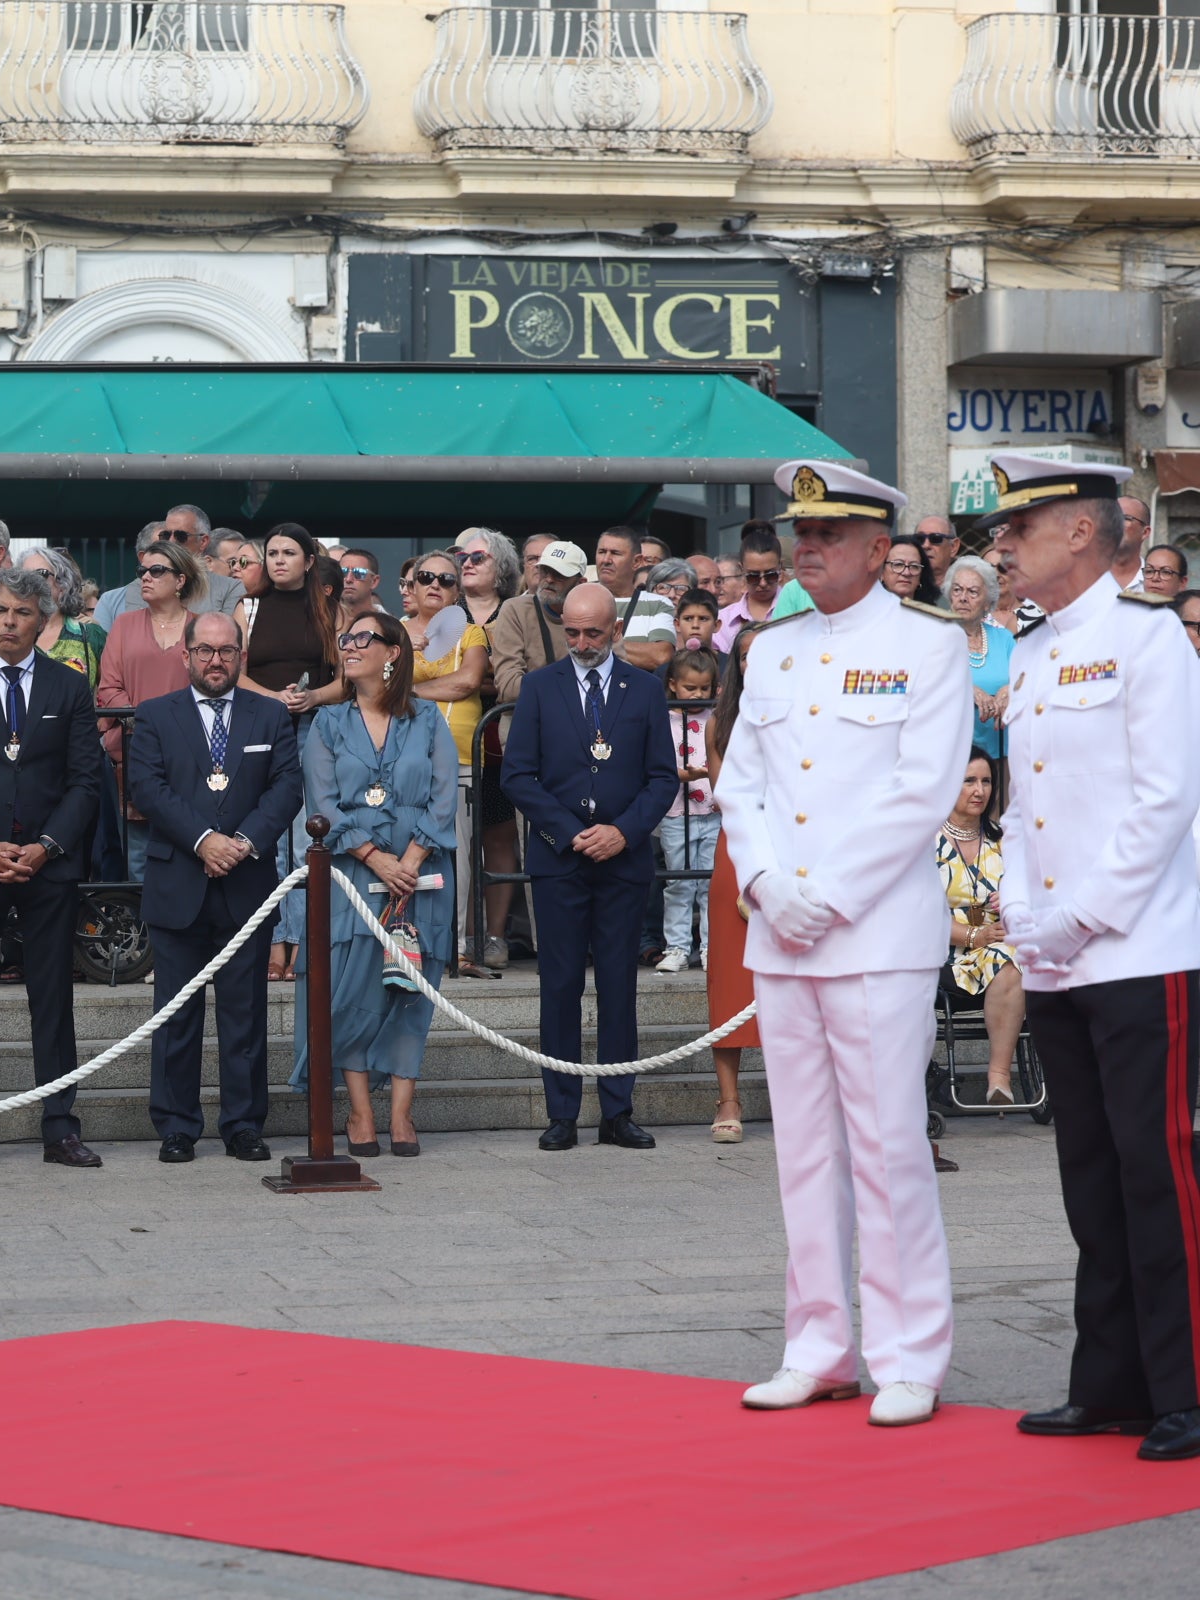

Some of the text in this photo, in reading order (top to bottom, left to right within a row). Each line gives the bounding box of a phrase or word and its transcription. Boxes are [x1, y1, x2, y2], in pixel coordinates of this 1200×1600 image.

[452, 260, 651, 293] LA VIEJA DE
[449, 290, 781, 360] PONCE
[947, 388, 1109, 433] JOYERIA
[551, 549, 567, 560] 201
